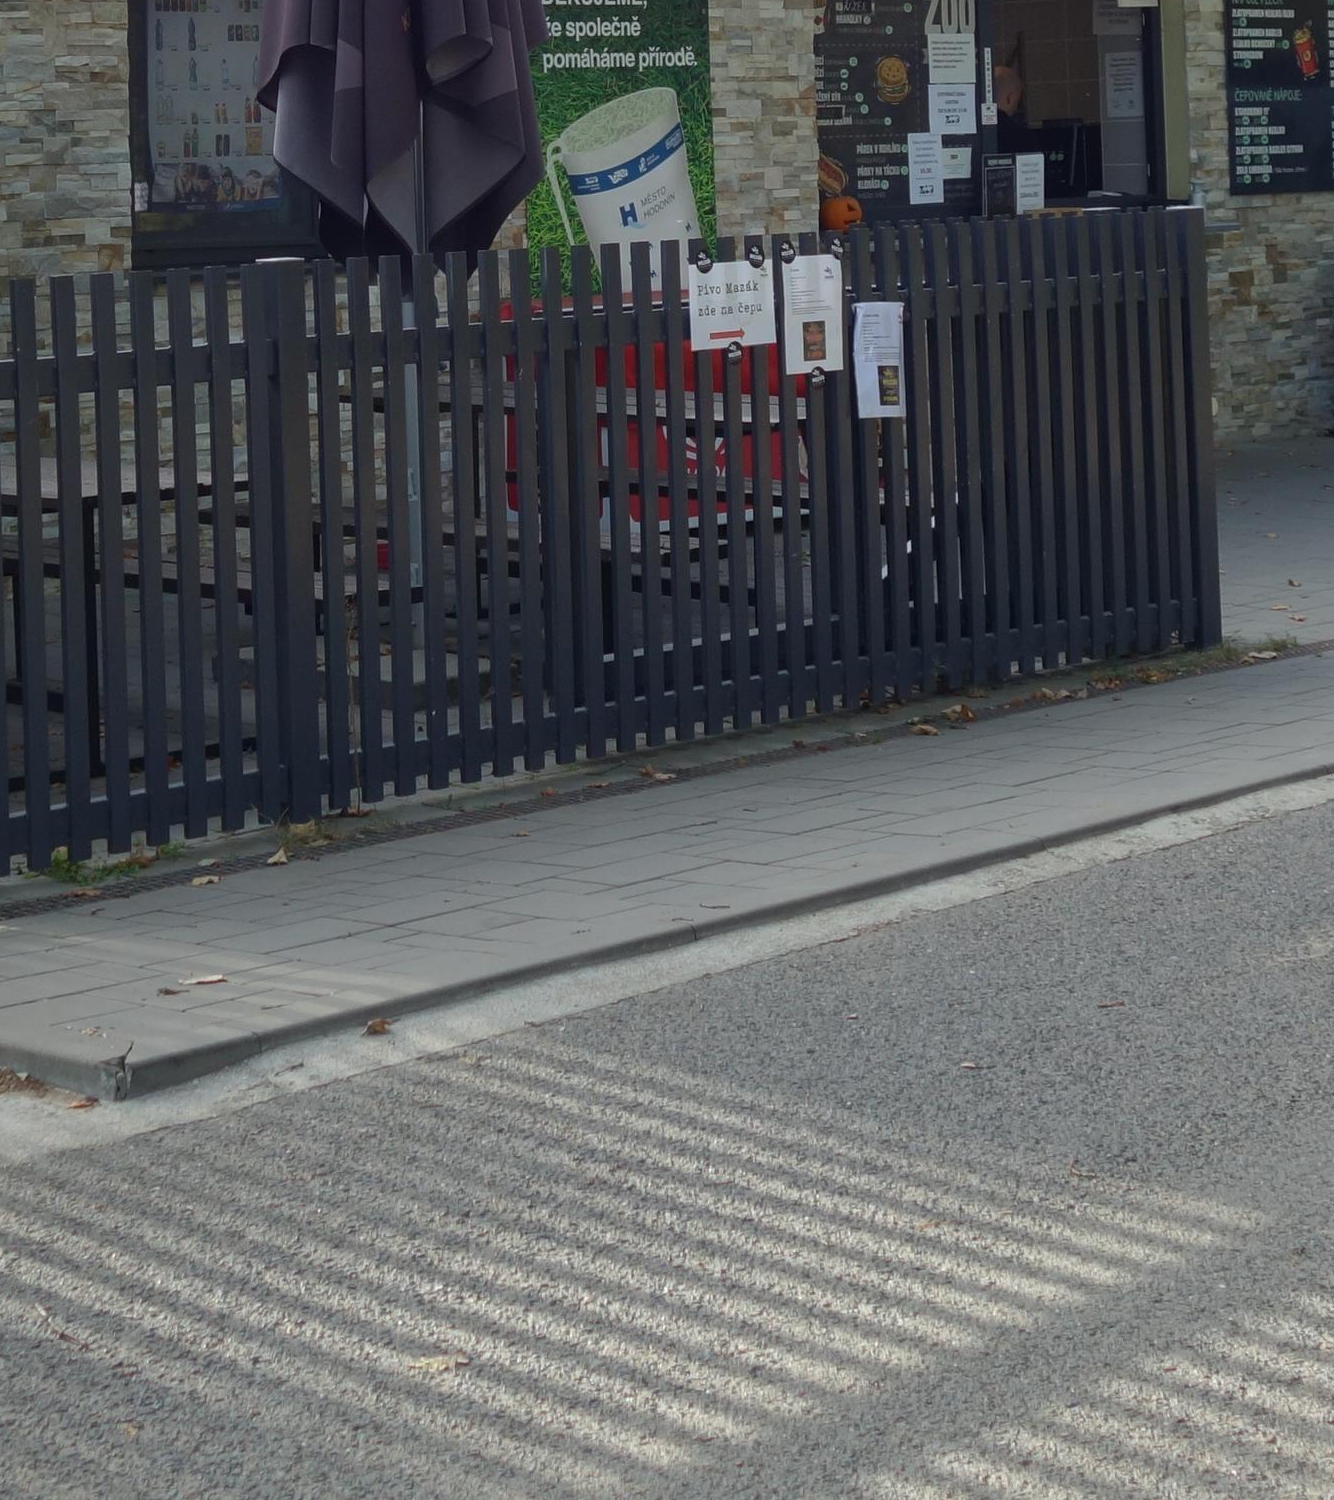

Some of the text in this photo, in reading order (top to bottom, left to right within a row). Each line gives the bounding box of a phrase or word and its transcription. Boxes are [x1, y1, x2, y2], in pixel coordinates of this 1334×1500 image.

[565, 16, 642, 42] společně
[543, 47, 635, 74] pomáháme
[643, 192, 676, 220] HODONÍN
[697, 280, 759, 296] Pivo Mazák
[698, 303, 762, 317] zde na čepu
